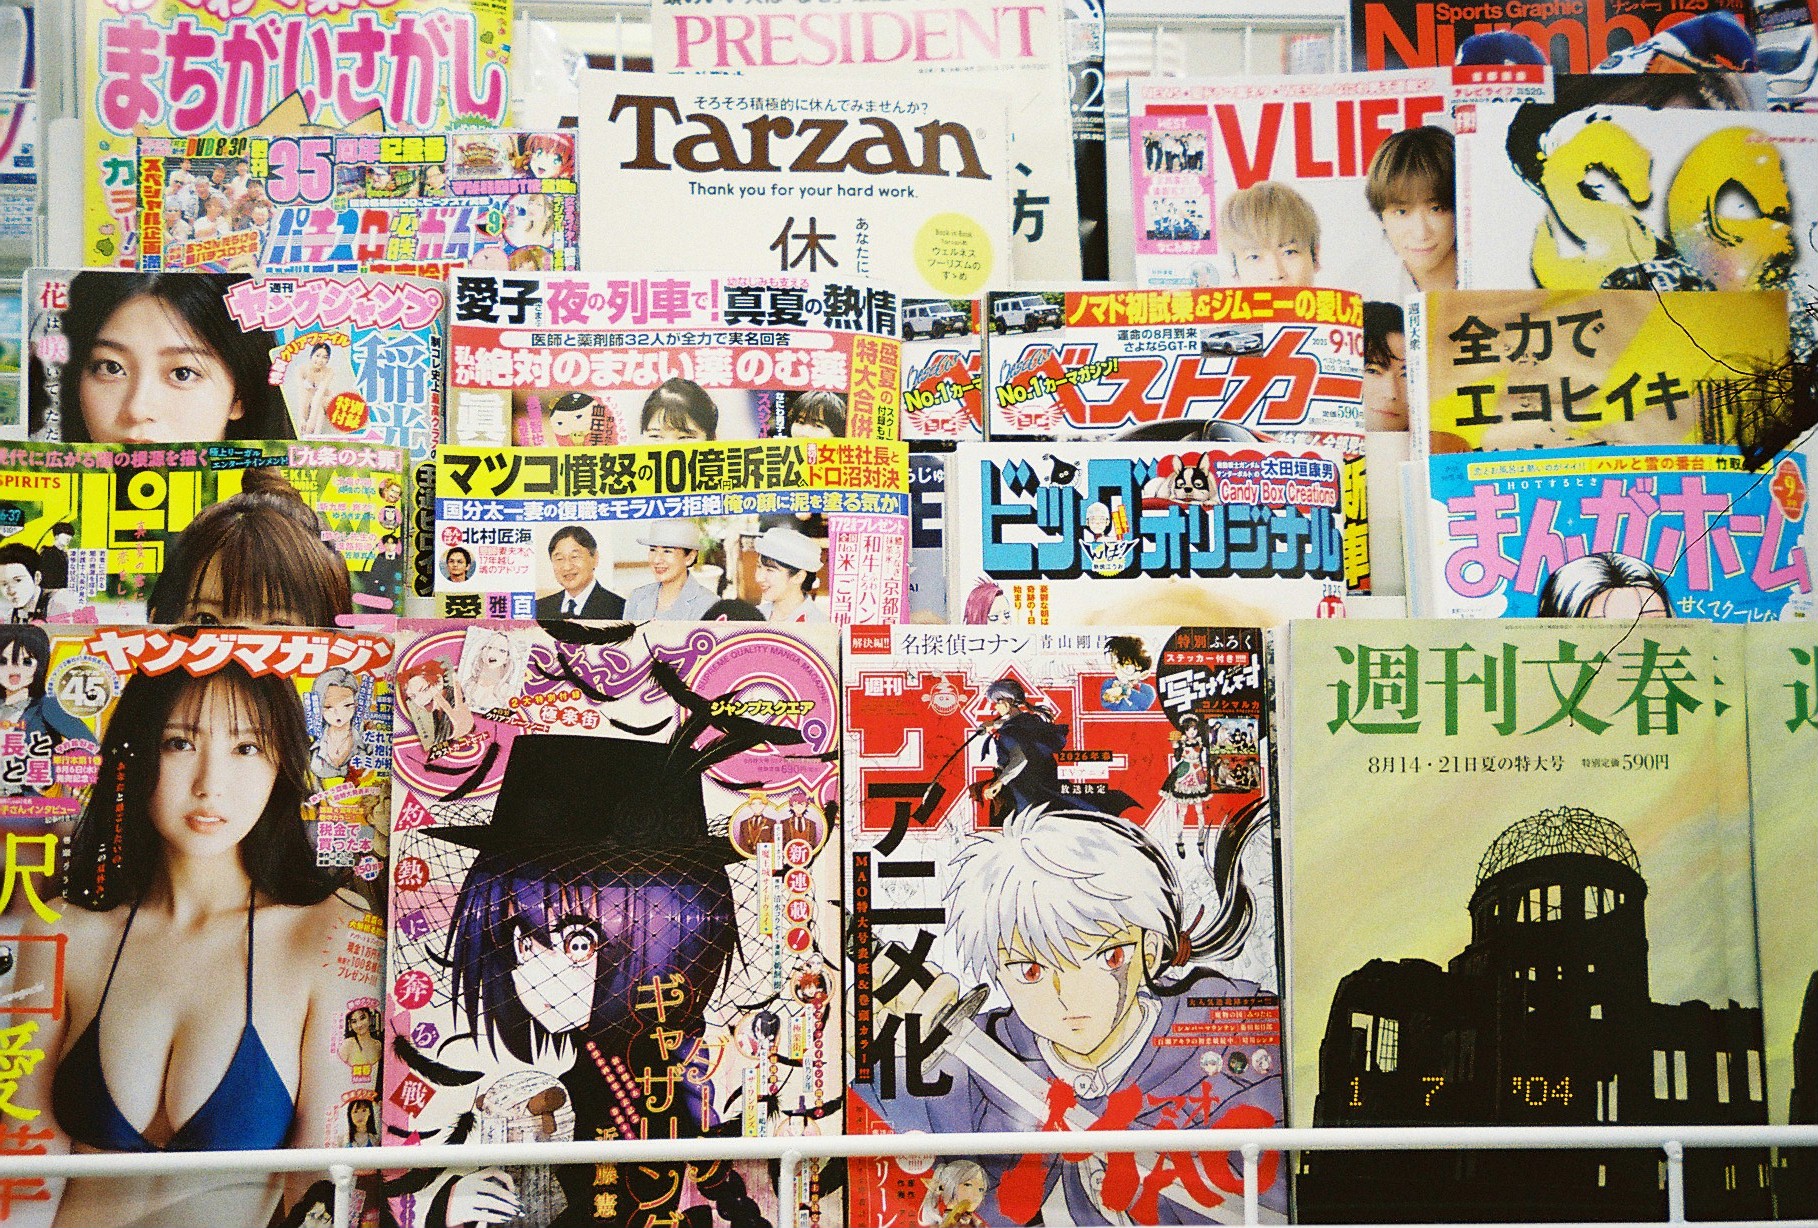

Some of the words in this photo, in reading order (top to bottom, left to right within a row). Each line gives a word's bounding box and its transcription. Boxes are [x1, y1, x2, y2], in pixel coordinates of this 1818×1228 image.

[1436, 3, 1503, 22] Sports
[1509, 1, 1584, 19] Graphic
[672, 7, 1047, 67] PRESIDENT
[103, 14, 502, 132] まちがいさがし
[608, 93, 993, 181] Tarzan
[269, 139, 332, 202] 35
[689, 181, 734, 197] Thank
[738, 185, 767, 199] you
[771, 182, 796, 197] for
[799, 186, 833, 200] your
[837, 183, 875, 198] hard
[879, 184, 920, 199] work.
[769, 216, 838, 272] 休
[269, 283, 293, 295] 週刊
[456, 276, 542, 324] 愛子
[229, 279, 442, 330] ヤングジャンプ
[546, 279, 719, 324] 夜の列車で!
[724, 284, 896, 337] 真夏の熱情
[531, 331, 791, 348] 医師と薬剤師32人が全力で実名回答
[1448, 309, 1605, 366] 全力で
[997, 375, 1044, 407] No.1
[1045, 358, 1119, 393] カーマガジン!
[904, 382, 951, 412] No.1
[1456, 372, 1690, 427] エコヒイキ
[818, 444, 900, 466] 女性社長と
[809, 467, 901, 489] ドロ沼対決
[1263, 460, 1333, 480] 太田垣康男
[1221, 481, 1258, 505] Candy
[1262, 483, 1285, 503] Box
[1287, 483, 1336, 506] Creations
[1507, 477, 1598, 490] HOTするとき
[1783, 475, 1797, 497] 9
[723, 492, 899, 515] 俺の顔に泥を塗る気か
[462, 528, 532, 544] 北村匠海
[1445, 475, 1812, 598] まんがホーム
[902, 633, 1030, 656] 名探偵コナン
[1177, 634, 1252, 650] 特別ふろく
[90, 632, 395, 678] ヤングマガジン
[697, 656, 731, 692] SUPREME
[730, 646, 768, 660] QUALITY
[769, 646, 802, 664] MANGA
[864, 677, 902, 697] 週刊
[1327, 638, 1704, 736] 週刊文春
[541, 705, 599, 729] 極楽街
[710, 701, 815, 717] ジャンプスクエア
[1202, 700, 1260, 710] コノシマルカ
[803, 718, 828, 752] 9
[1060, 751, 1111, 761] 2026年春
[1060, 784, 1106, 794] 放送決定
[318, 823, 361, 837] 税金で
[318, 838, 373, 851] 買った本
[868, 782, 954, 1100] アニメ化
